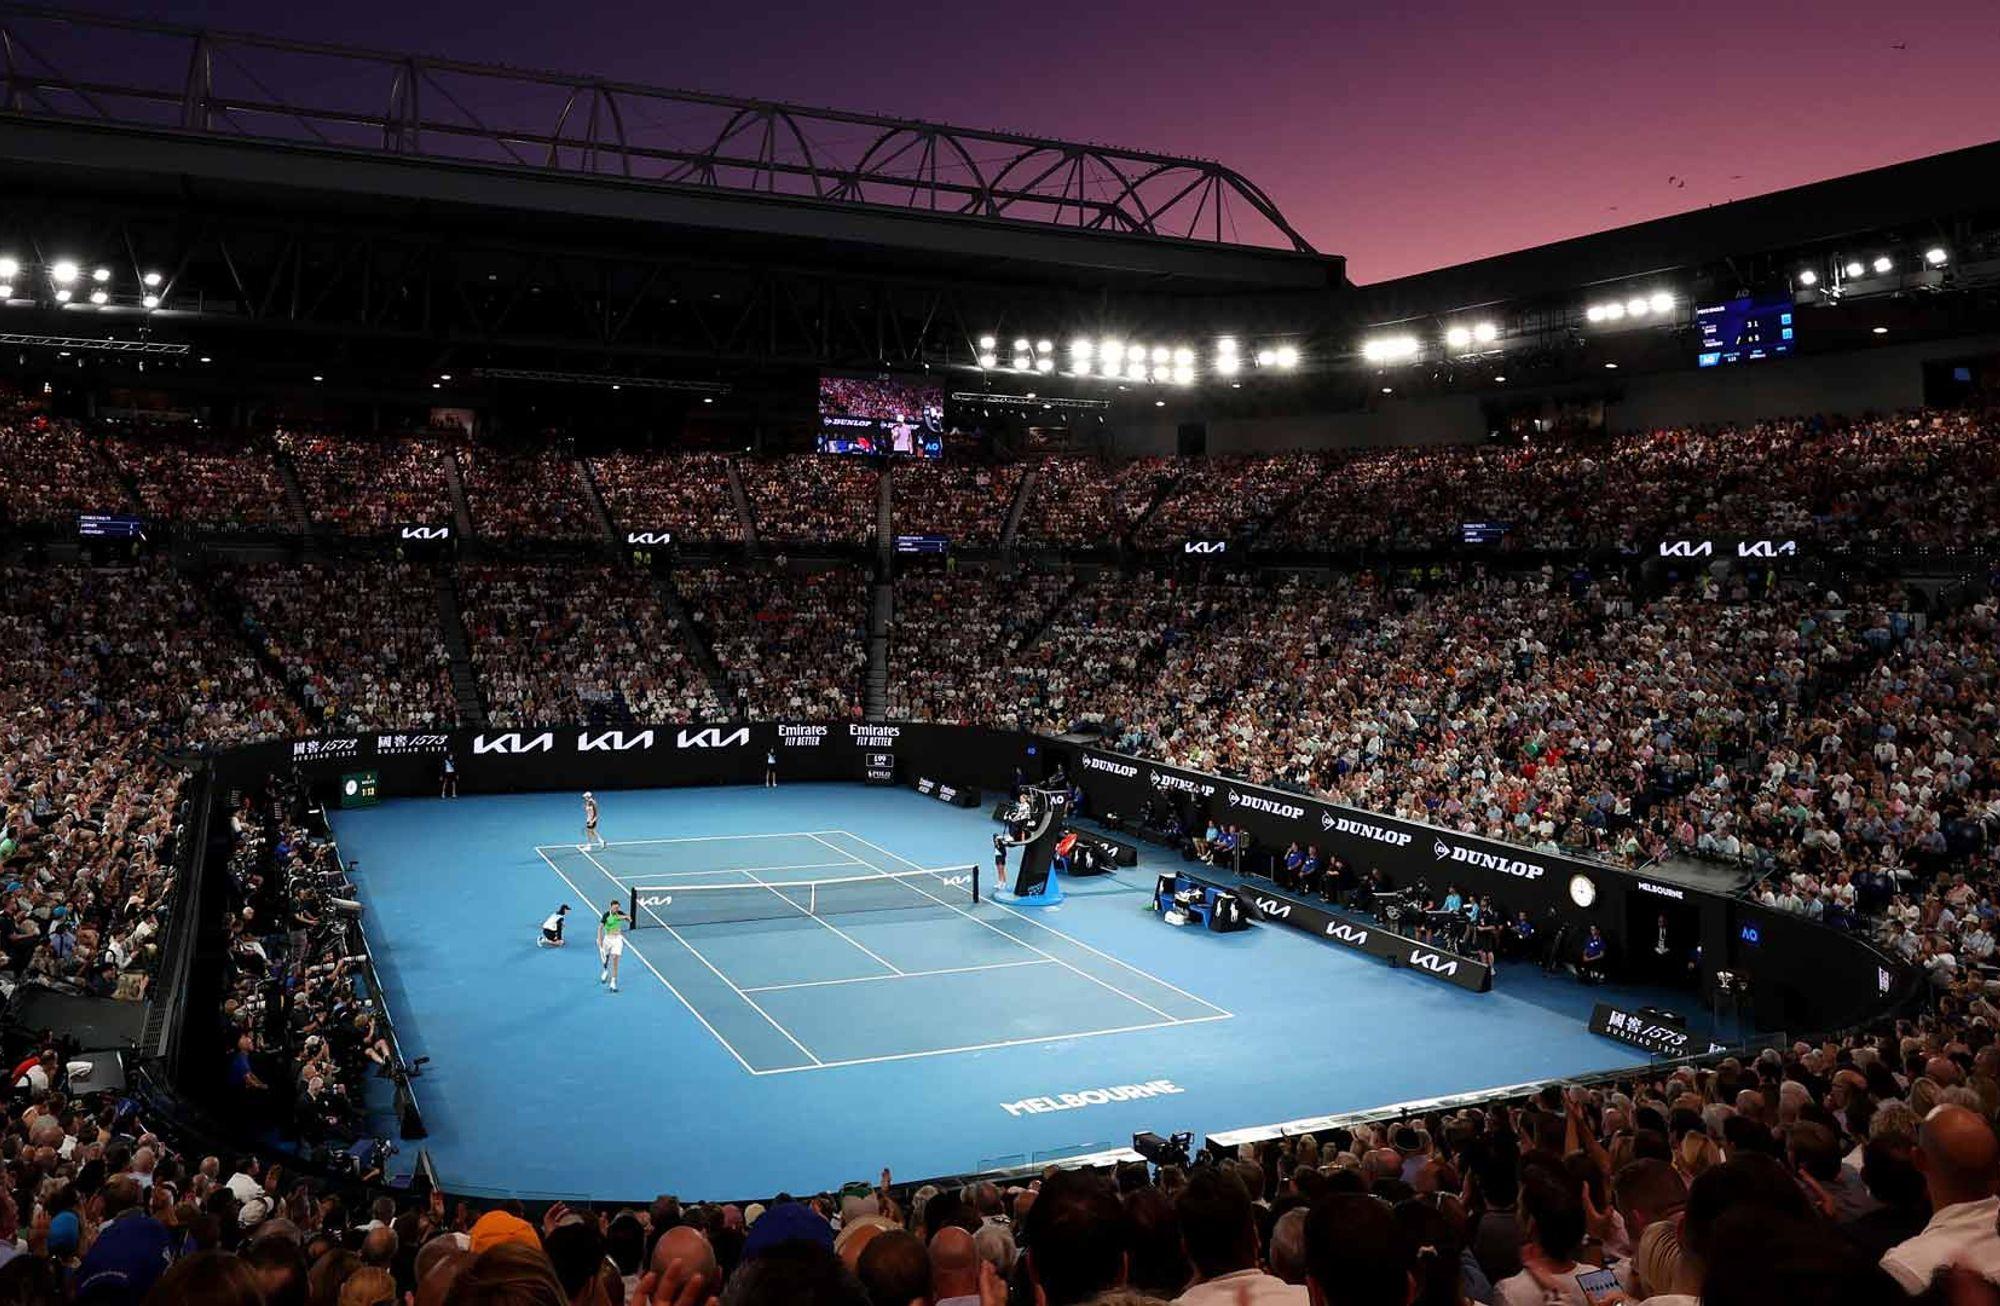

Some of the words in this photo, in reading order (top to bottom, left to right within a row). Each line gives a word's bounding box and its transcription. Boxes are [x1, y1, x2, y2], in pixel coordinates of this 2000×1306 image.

[832, 418, 872, 427] DUNLOP
[925, 442, 939, 451] AO
[402, 527, 448, 539] KIA
[628, 533, 670, 544] KIA
[1185, 541, 1225, 553] KIA
[1660, 540, 1712, 557] KIA
[678, 728, 750, 748] KIA
[778, 724, 828, 737] Emirates
[849, 724, 900, 738] Emirates
[473, 732, 554, 754] KIA
[577, 730, 654, 751] KIA
[784, 736, 798, 746] FLY
[799, 736, 820, 746] BETTER
[856, 736, 868, 746] FLY
[869, 736, 893, 747] BETTER
[1091, 759, 1138, 778] DUNLOP
[1050, 795, 1064, 805] AO
[1241, 794, 1305, 820] DUNLOP
[1336, 817, 1412, 847] DUNLOP
[1451, 845, 1544, 880] DUNLOP
[1638, 881, 1684, 900] MELBOURNE
[1256, 896, 1292, 919] KIA
[1326, 920, 1368, 945] KIA
[1742, 926, 1758, 942] AO
[1410, 949, 1458, 976] KIA
[999, 1078, 1185, 1116] MELBOURNE
